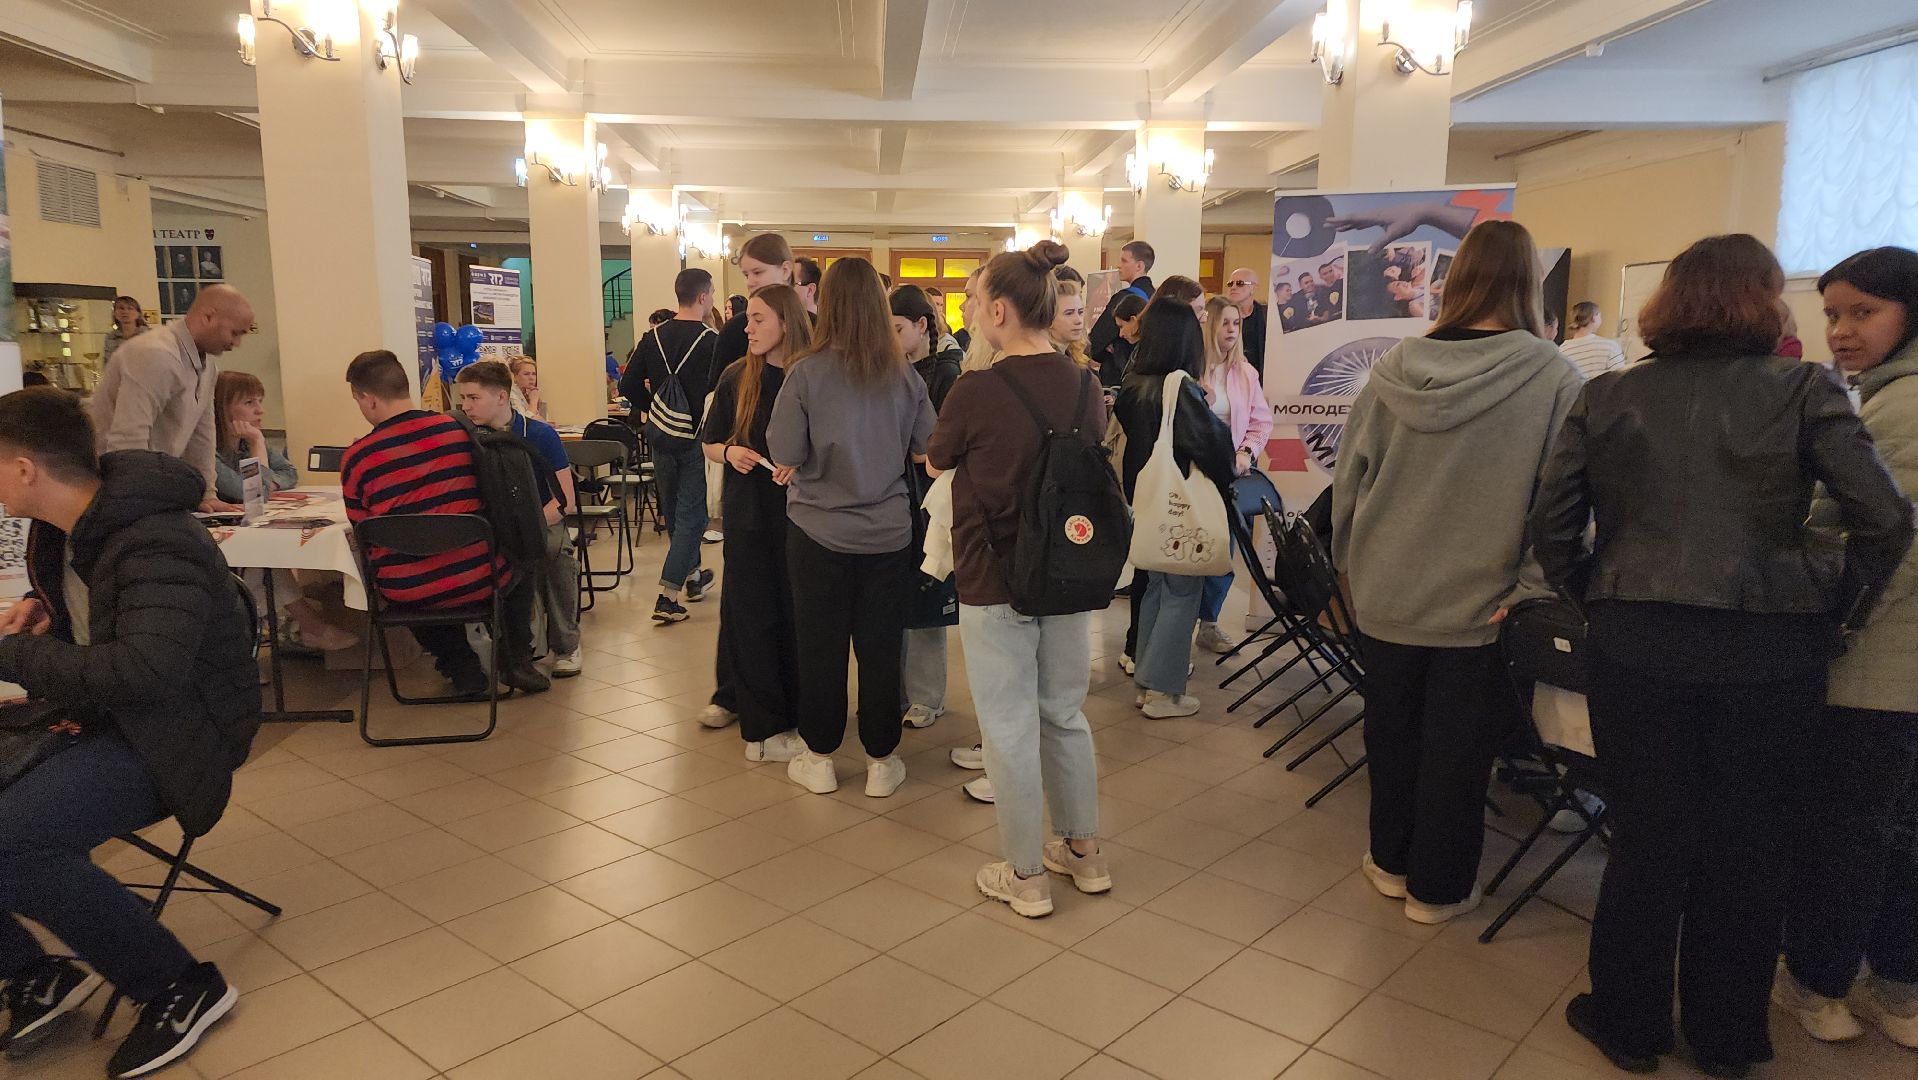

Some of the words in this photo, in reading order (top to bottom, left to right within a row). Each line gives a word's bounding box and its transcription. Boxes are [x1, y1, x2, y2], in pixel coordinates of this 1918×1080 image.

[160, 229, 201, 239] ТЕАТР
[1273, 404, 1351, 416] МОЛОДЕ
[1168, 500, 1190, 510] happy
